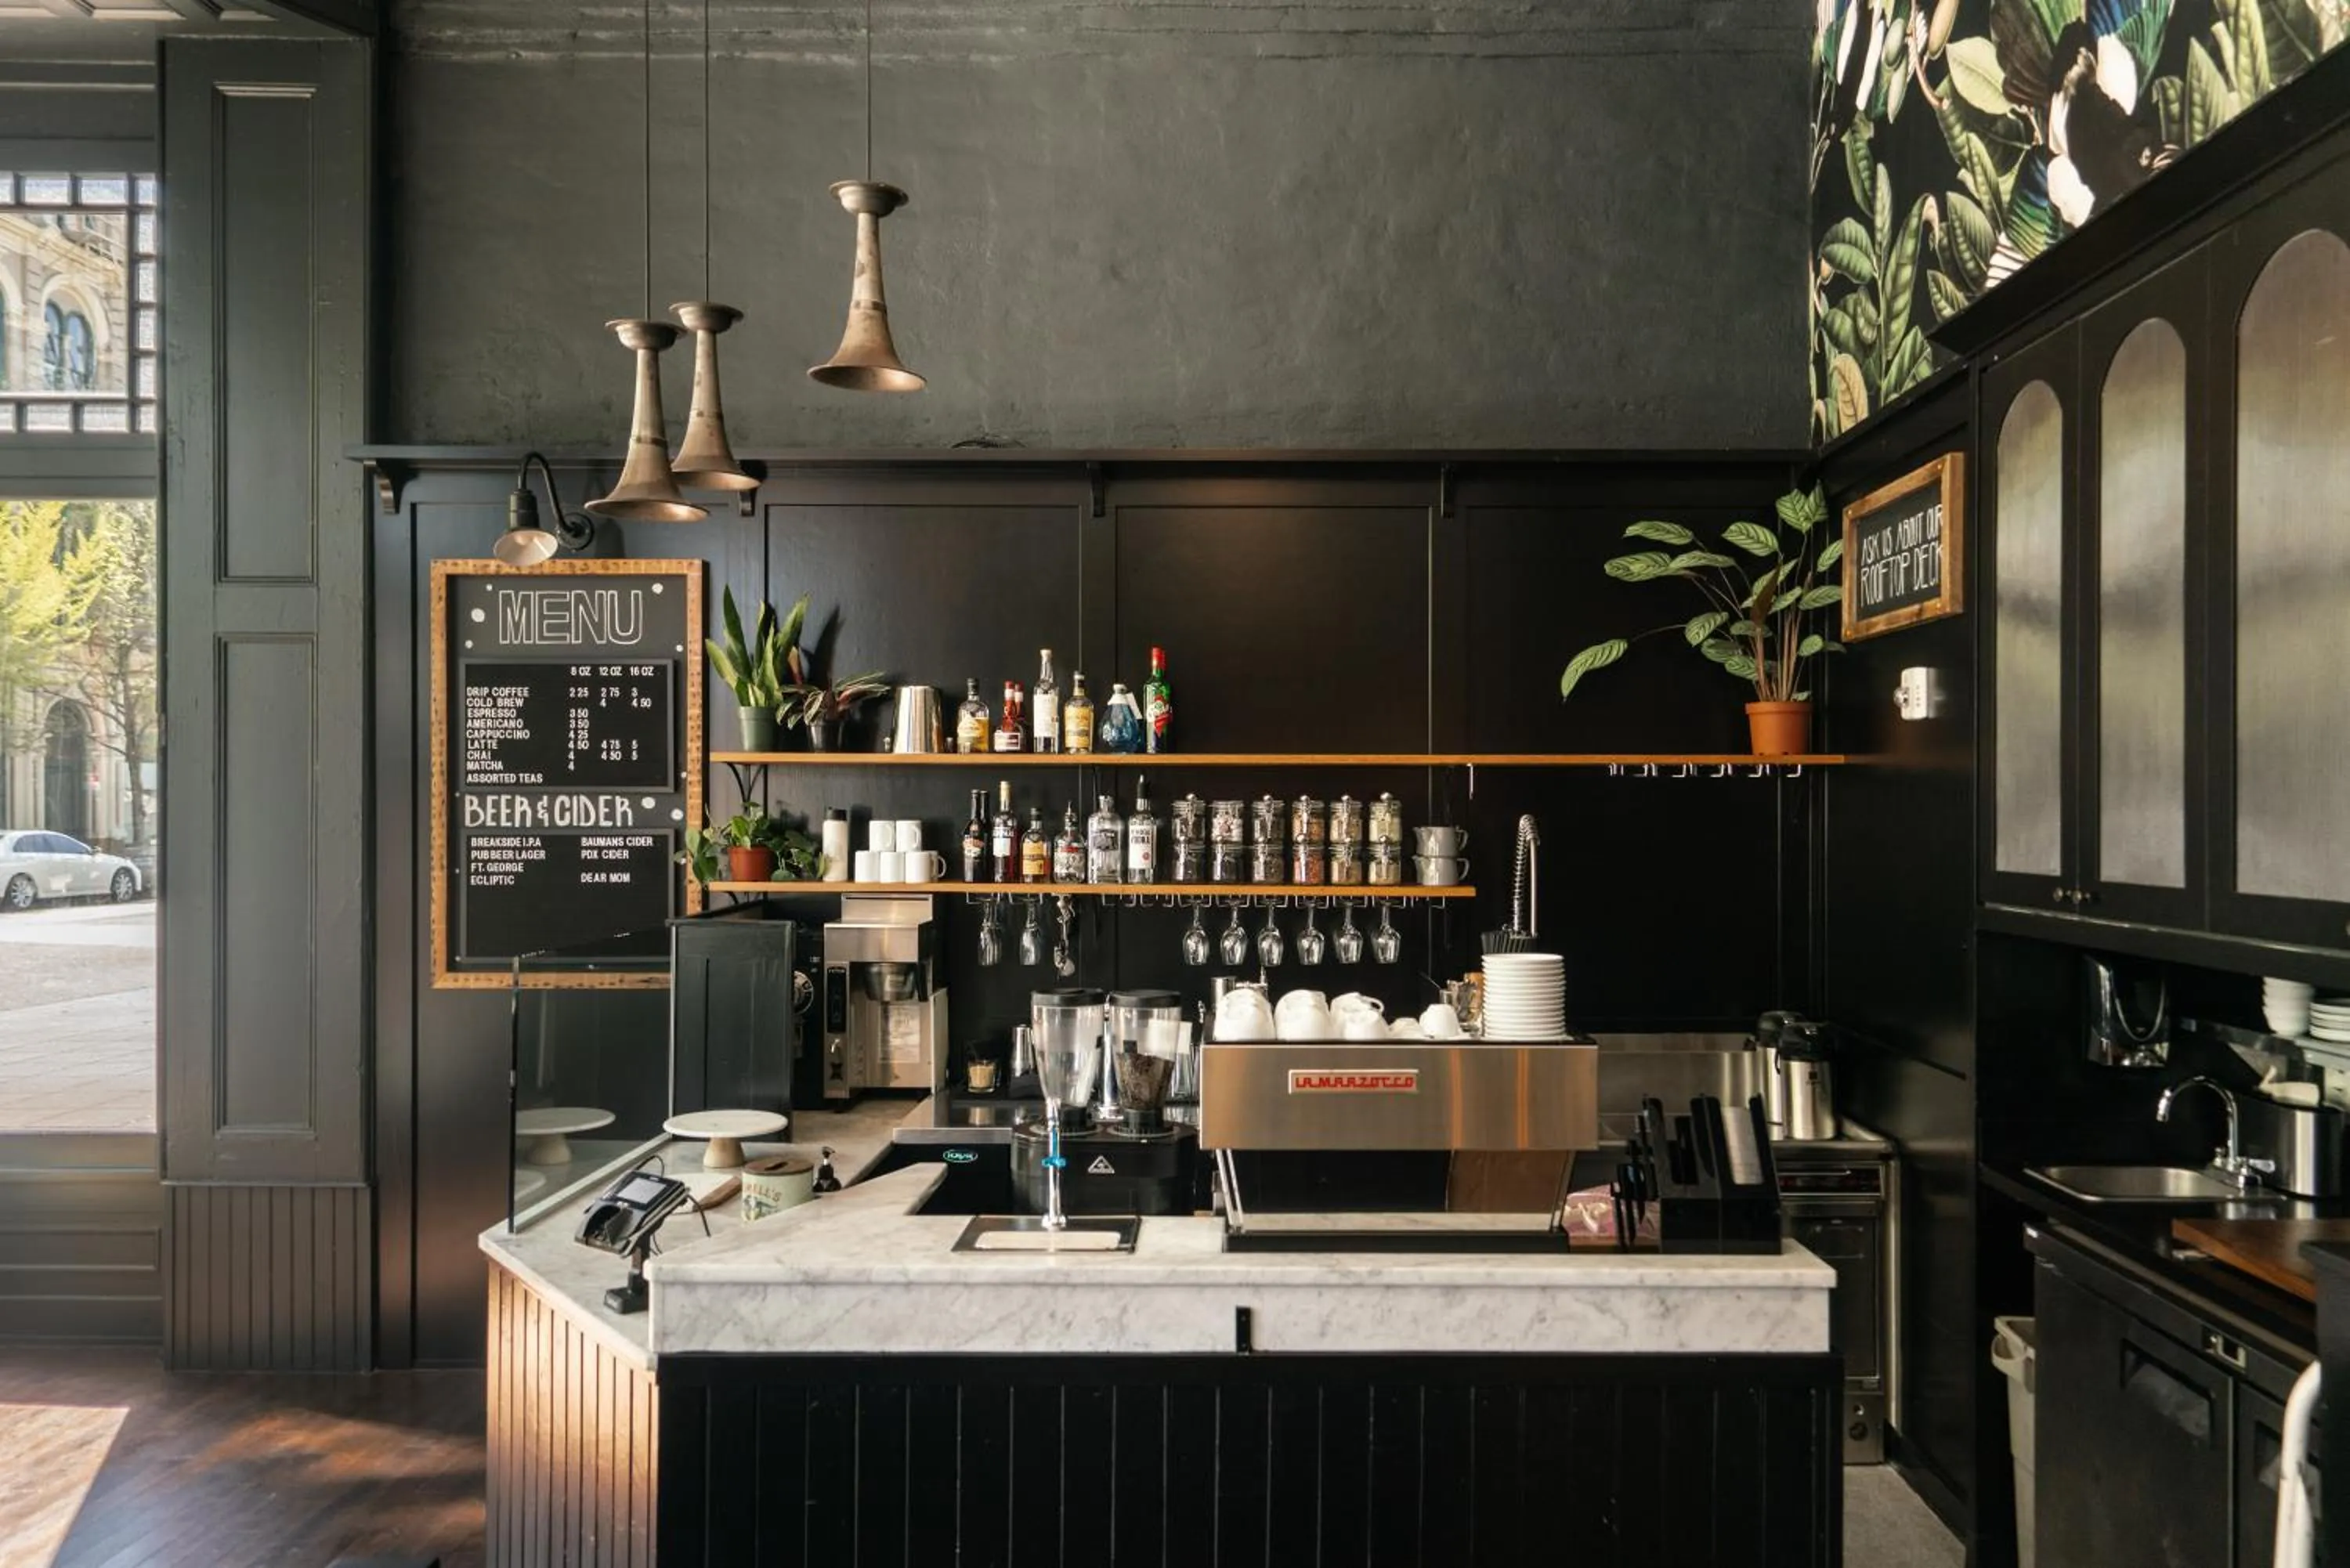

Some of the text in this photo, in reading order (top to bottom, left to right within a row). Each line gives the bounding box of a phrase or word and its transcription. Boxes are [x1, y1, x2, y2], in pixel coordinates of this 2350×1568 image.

[1861, 504, 1943, 565] ASK US ABOUT OUR
[1860, 540, 1943, 608] ROOFTOP DECK
[499, 590, 643, 645] MENU
[570, 666, 591, 676] 8 OZ
[599, 666, 623, 676] 12 OZ
[630, 666, 654, 677] 16 OZ
[466, 686, 530, 698] DRIP COFFEE
[631, 686, 638, 698] 3
[466, 697, 524, 708] COLD BREW
[600, 697, 607, 708] 4
[467, 707, 517, 718] ESPRESSO
[466, 718, 524, 729] AMERICANO
[466, 729, 531, 739] CAPPUCCINO
[468, 739, 498, 750] LATTE
[467, 750, 491, 761] CHAI
[568, 750, 575, 761] 4
[466, 761, 504, 771] MATCHA
[568, 761, 575, 771] 4
[466, 772, 543, 784] ASSORTED TEAS
[464, 794, 634, 828] BEER & CIDER
[471, 836, 522, 847] BREAKSIDE
[580, 836, 653, 847] BAUMANS CIDER
[515, 849, 547, 860] LAGER
[601, 849, 630, 859] CIDER
[471, 862, 525, 873] FT. GEORGE
[471, 875, 515, 886] ECLIPTIC
[580, 872, 631, 883] DEAR MOM
